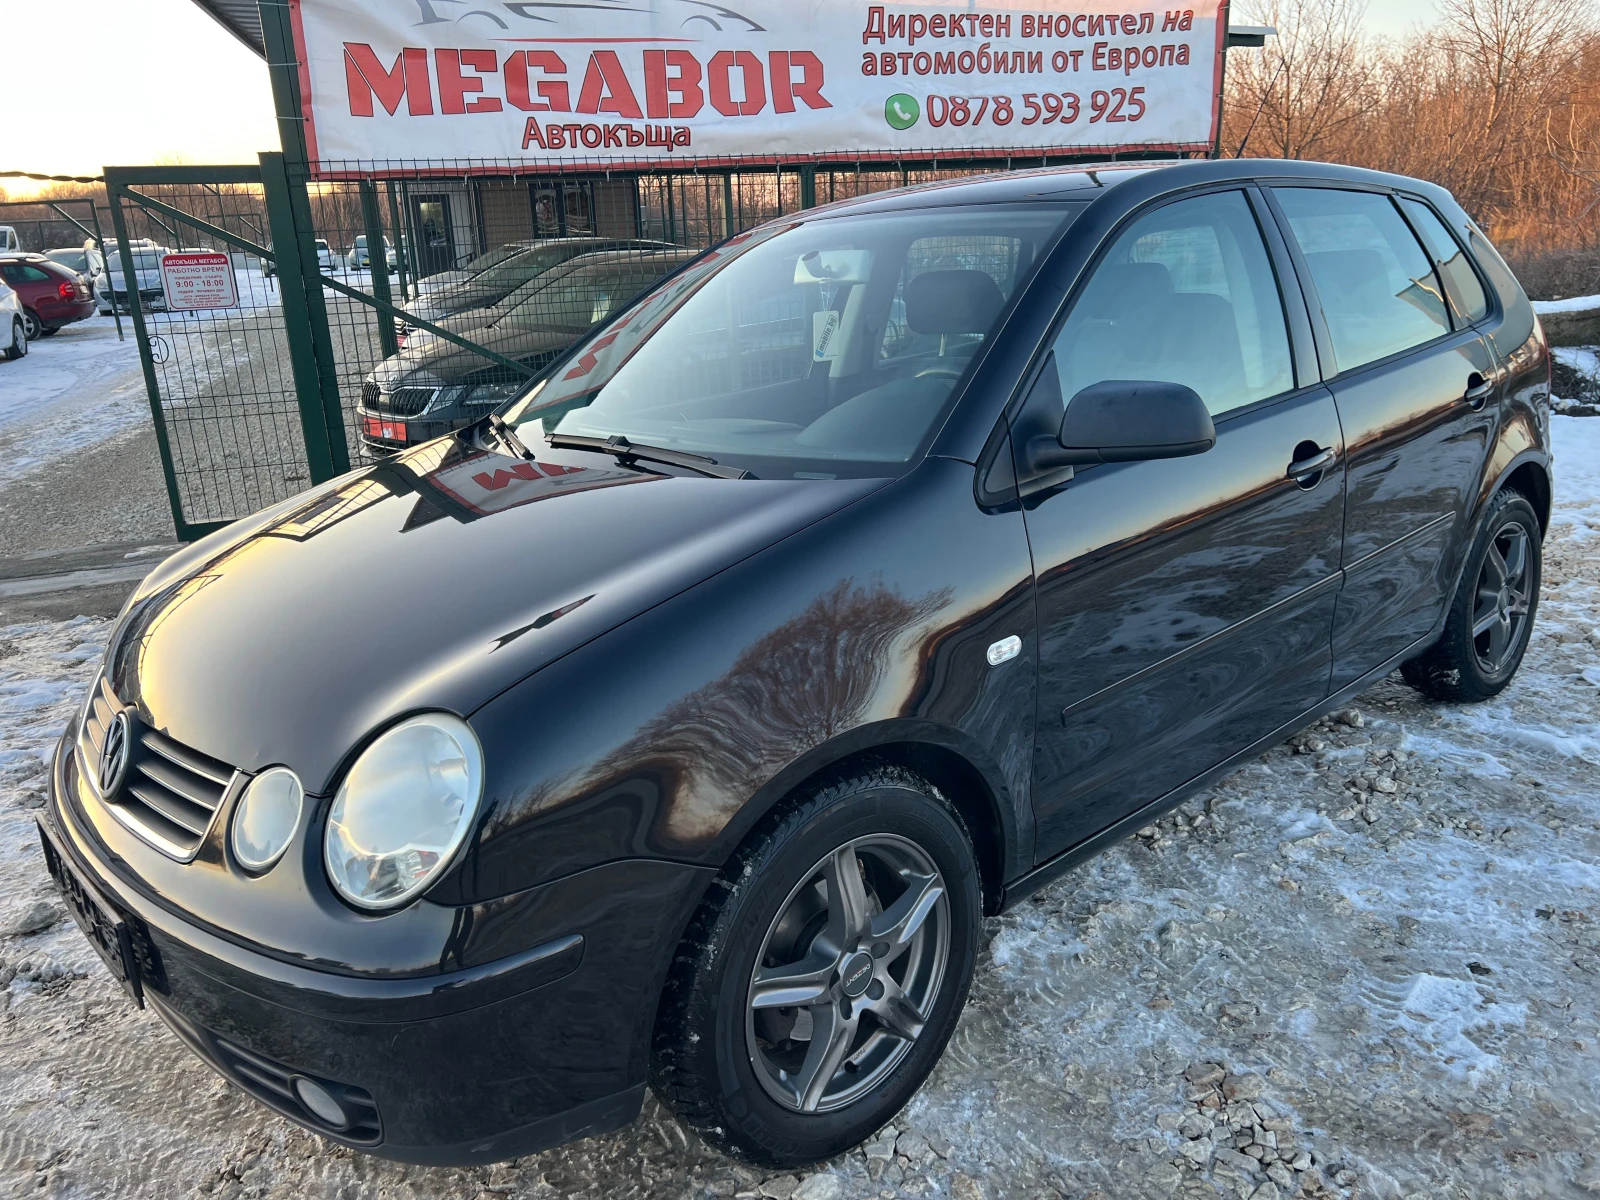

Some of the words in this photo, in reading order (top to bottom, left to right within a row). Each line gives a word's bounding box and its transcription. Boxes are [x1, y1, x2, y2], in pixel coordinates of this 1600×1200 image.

[862, 6, 1011, 45] Директен
[1021, 12, 1154, 38] вносител
[1161, 9, 1194, 33] на
[861, 42, 1043, 76] автомобили
[1051, 49, 1084, 73] от
[1092, 41, 1190, 76] Европа
[342, 41, 834, 118] MEGABOR
[926, 94, 1014, 128] 0878
[1022, 92, 1080, 126] 593
[1090, 87, 1146, 124] 925
[521, 116, 691, 152] Автокъща
